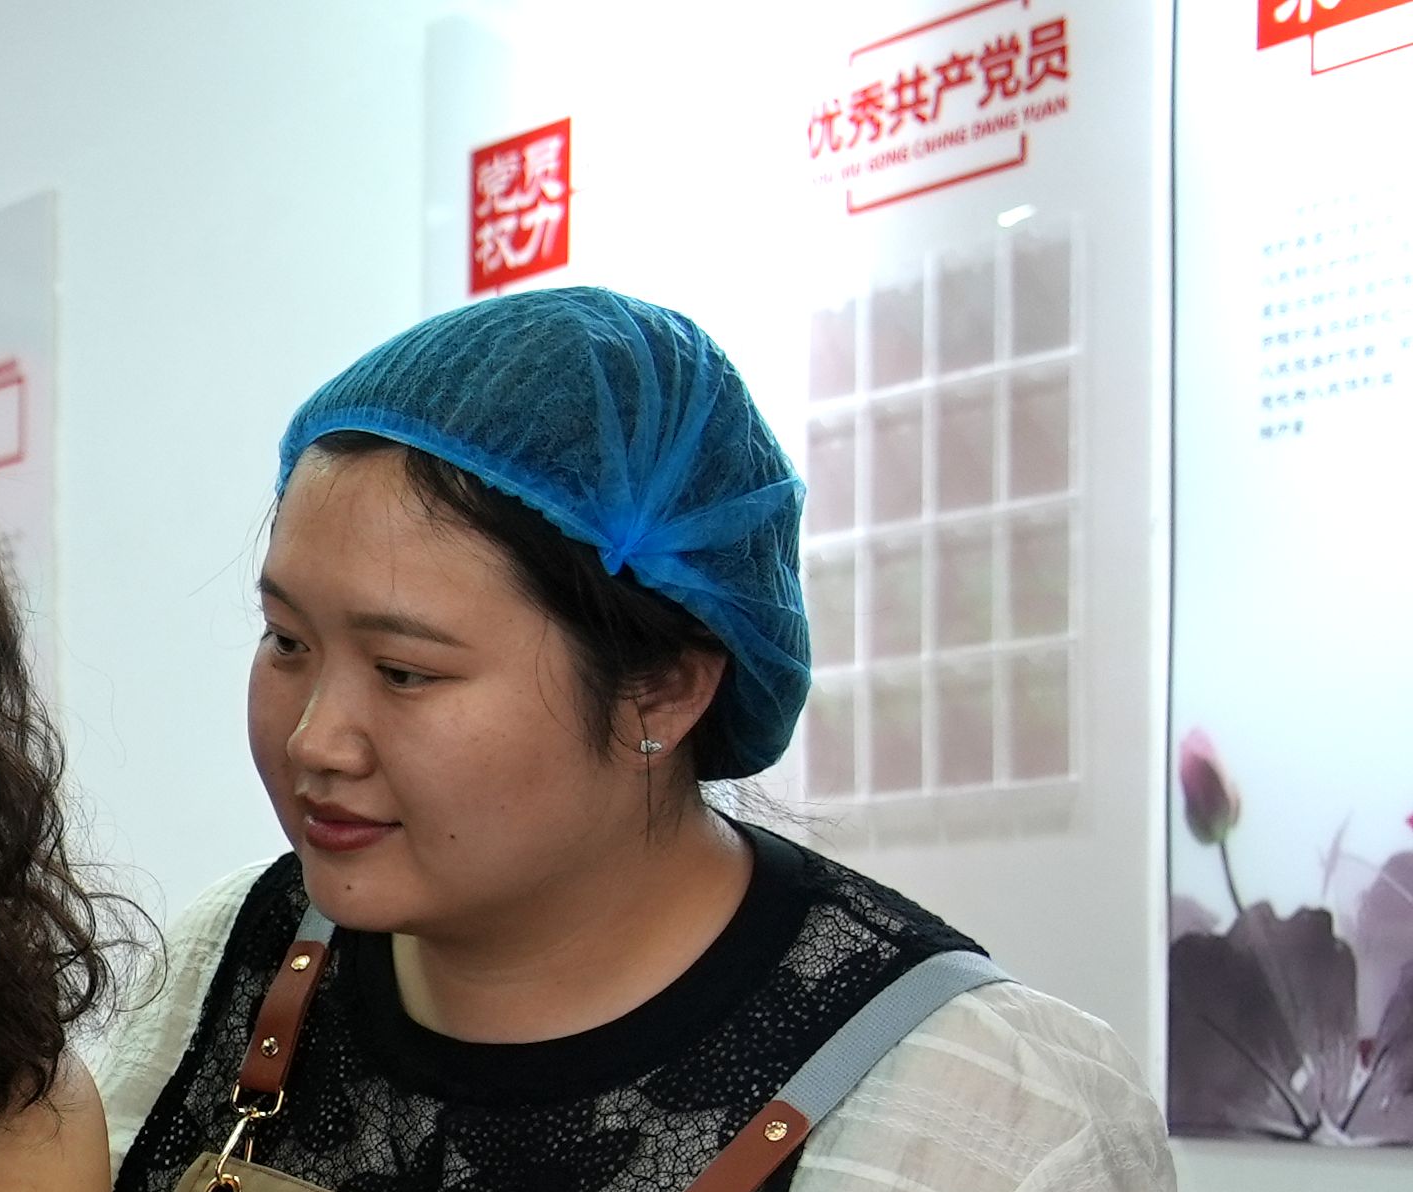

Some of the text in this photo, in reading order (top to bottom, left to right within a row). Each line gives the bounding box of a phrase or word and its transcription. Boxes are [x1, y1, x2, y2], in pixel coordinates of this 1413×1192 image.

[807, 15, 1070, 160] 优秀共产党员
